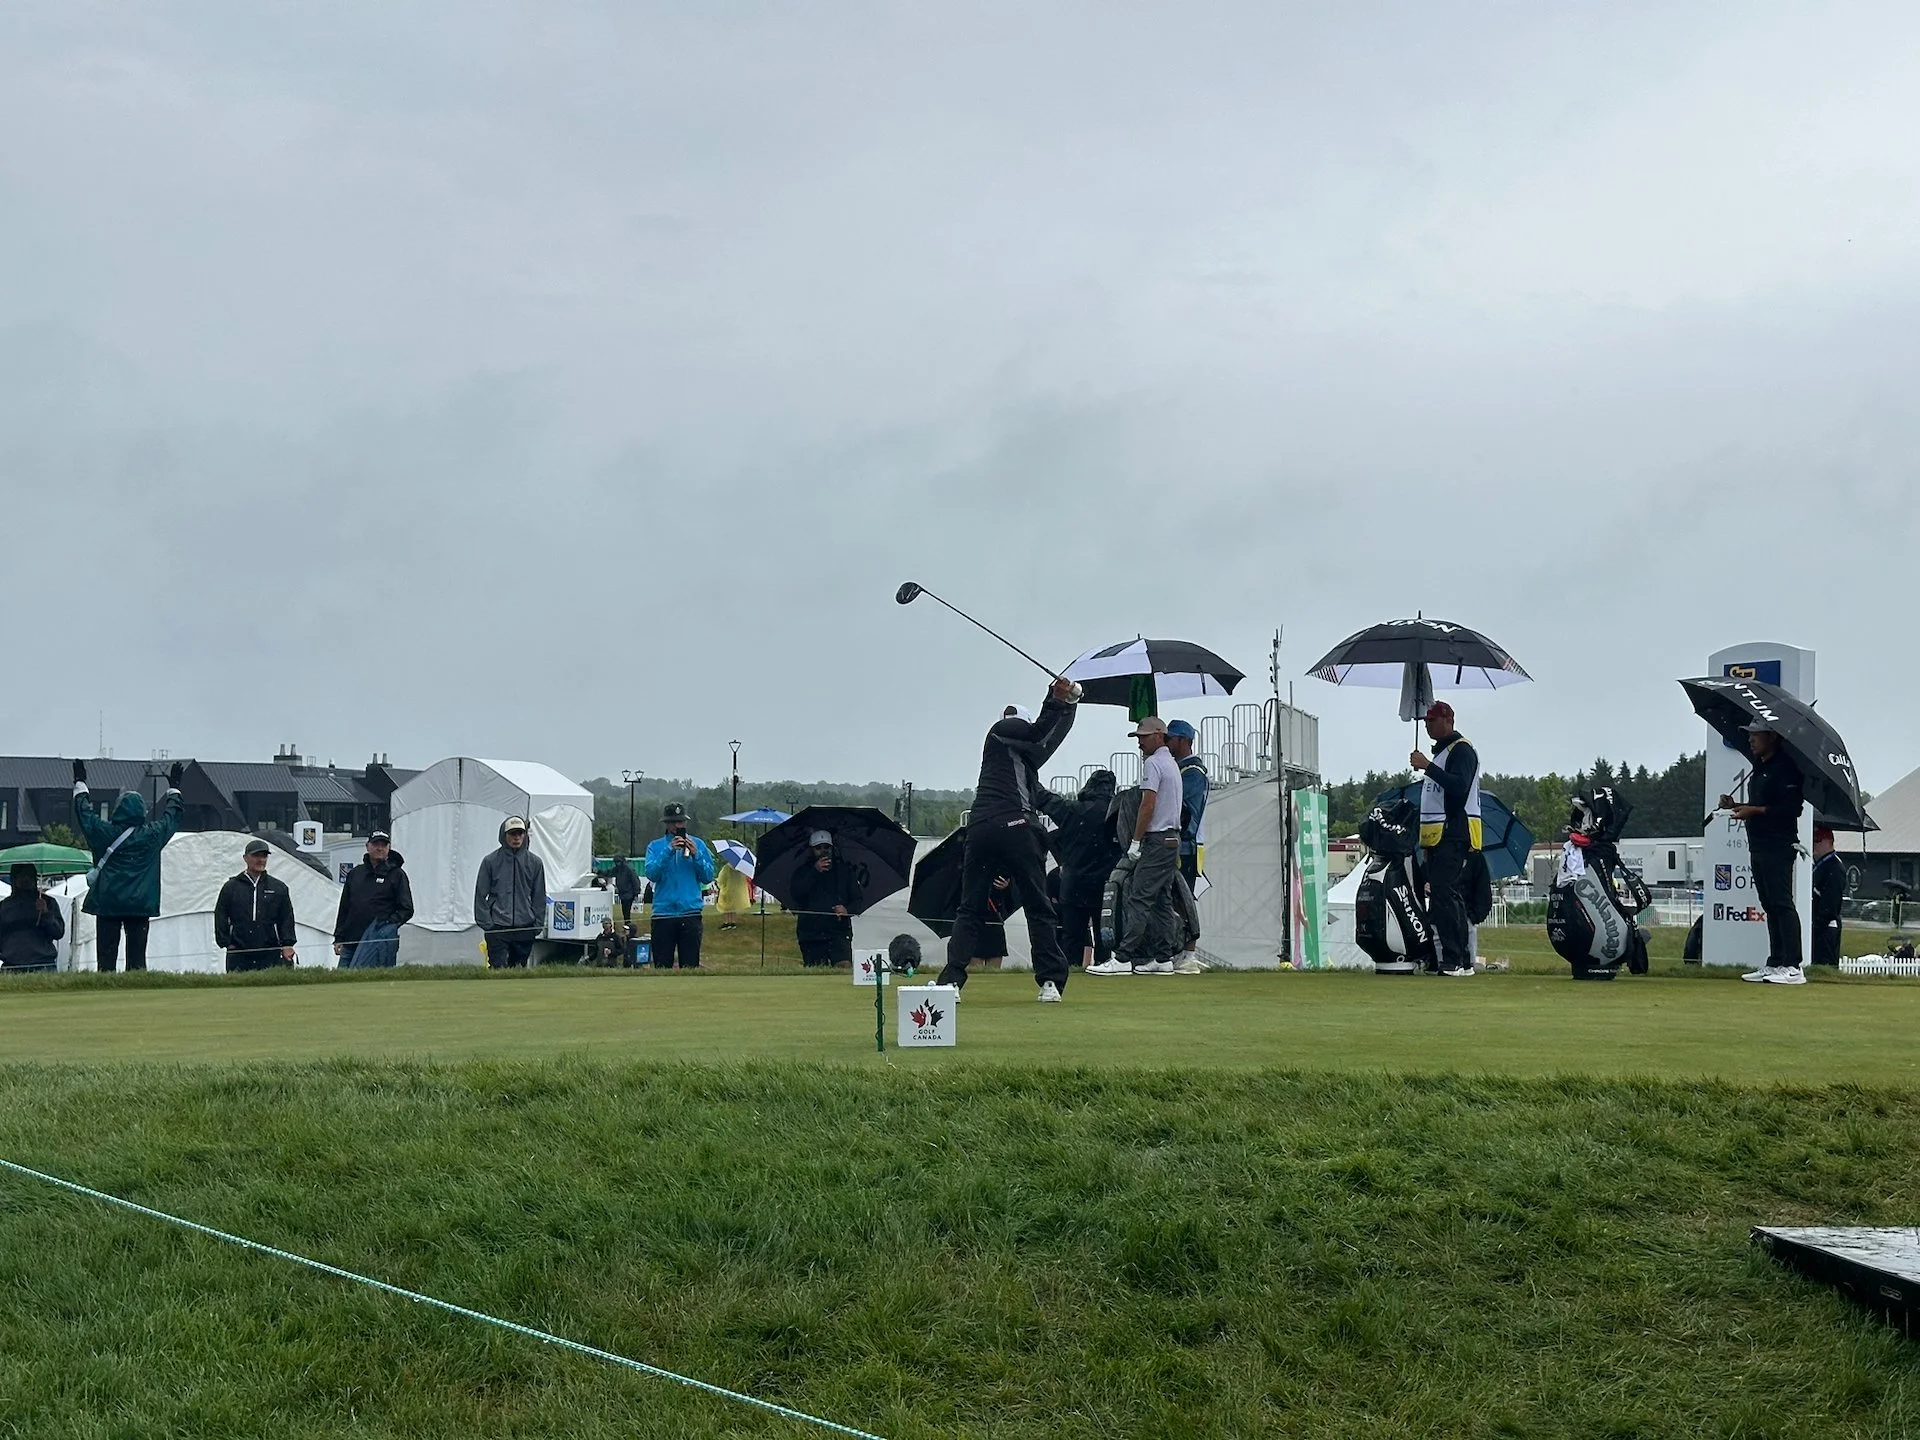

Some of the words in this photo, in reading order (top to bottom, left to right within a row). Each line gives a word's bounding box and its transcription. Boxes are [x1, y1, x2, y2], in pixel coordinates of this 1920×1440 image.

[1726, 840, 1742, 848] 416
[1393, 884, 1428, 943] SRIXON
[1574, 878, 1620, 959] Callaway
[1726, 907, 1765, 921] FedEx
[554, 921, 574, 930] RBC
